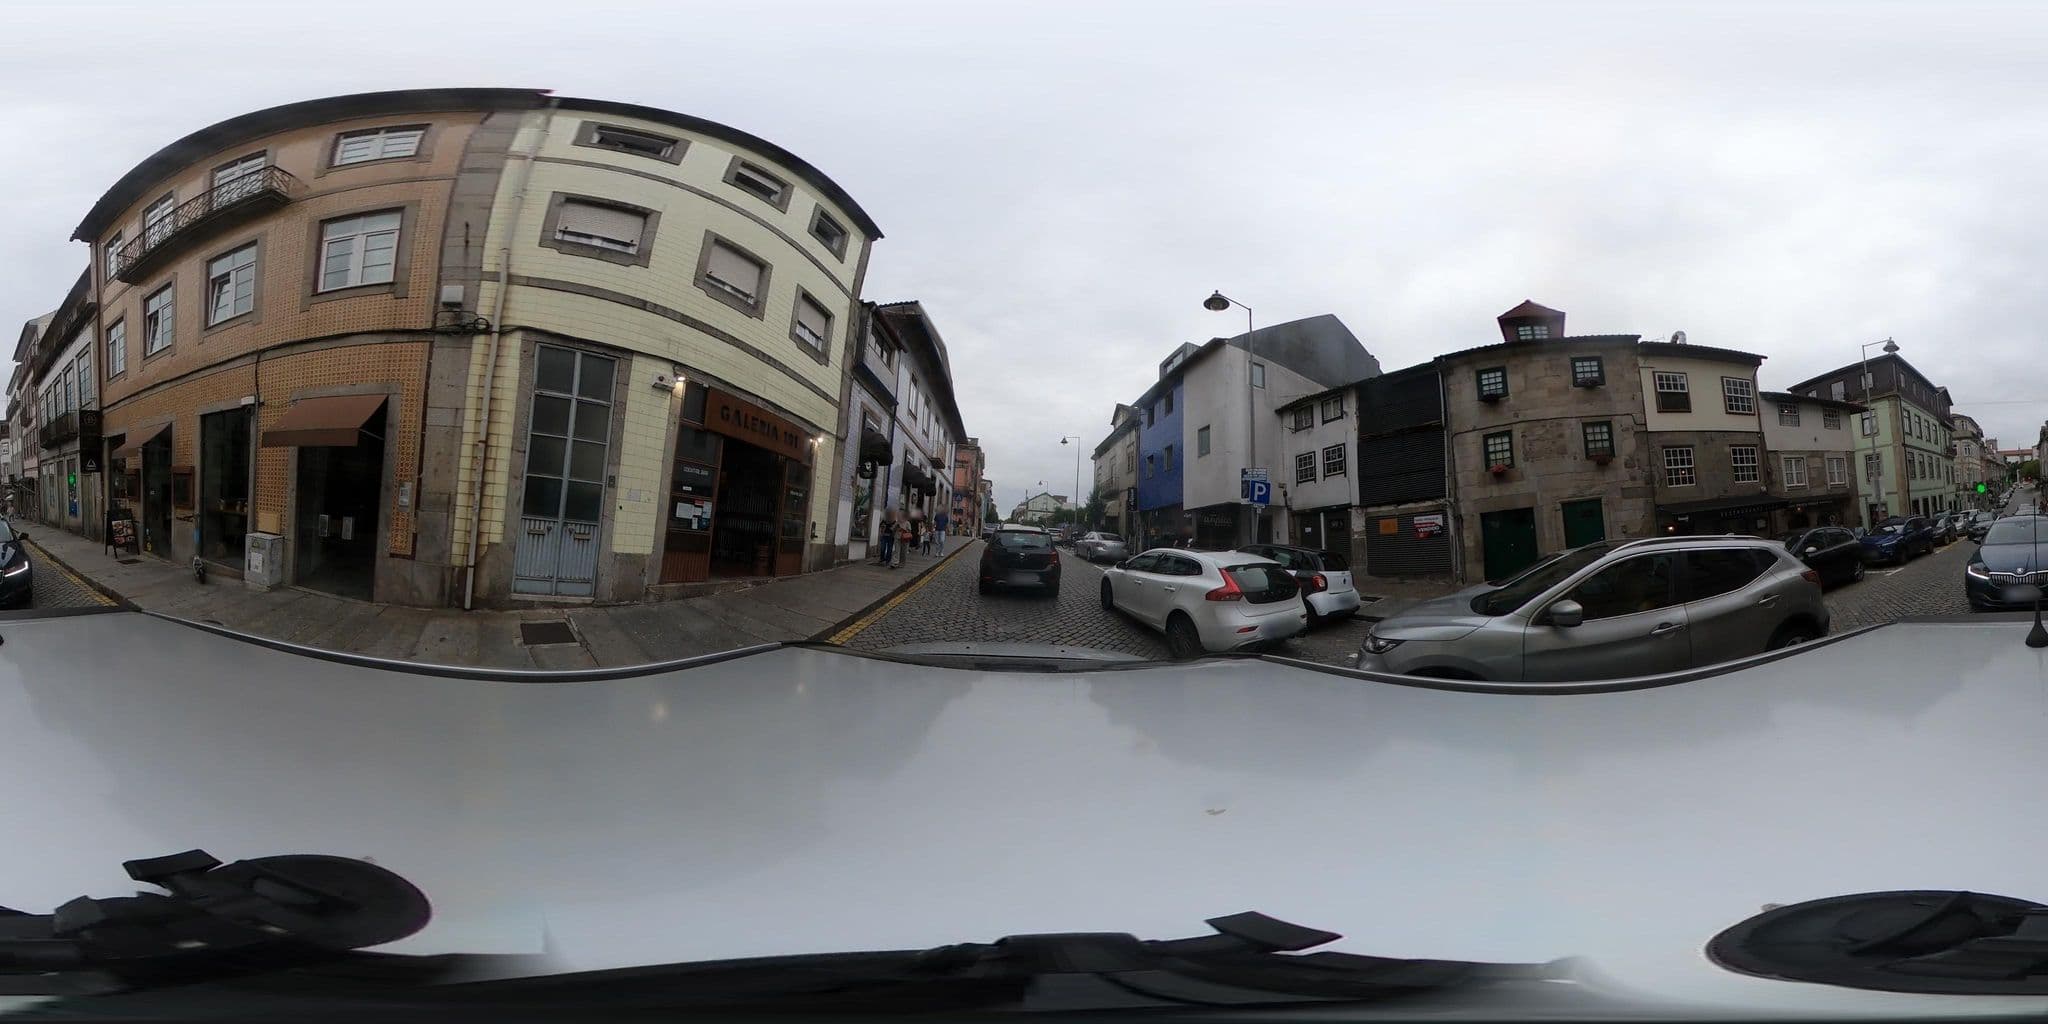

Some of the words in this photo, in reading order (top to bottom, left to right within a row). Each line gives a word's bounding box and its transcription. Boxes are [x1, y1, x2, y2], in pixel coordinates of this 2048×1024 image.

[720, 405, 778, 441] GALERIA
[784, 431, 799, 449] 101
[1254, 483, 1267, 501] P
